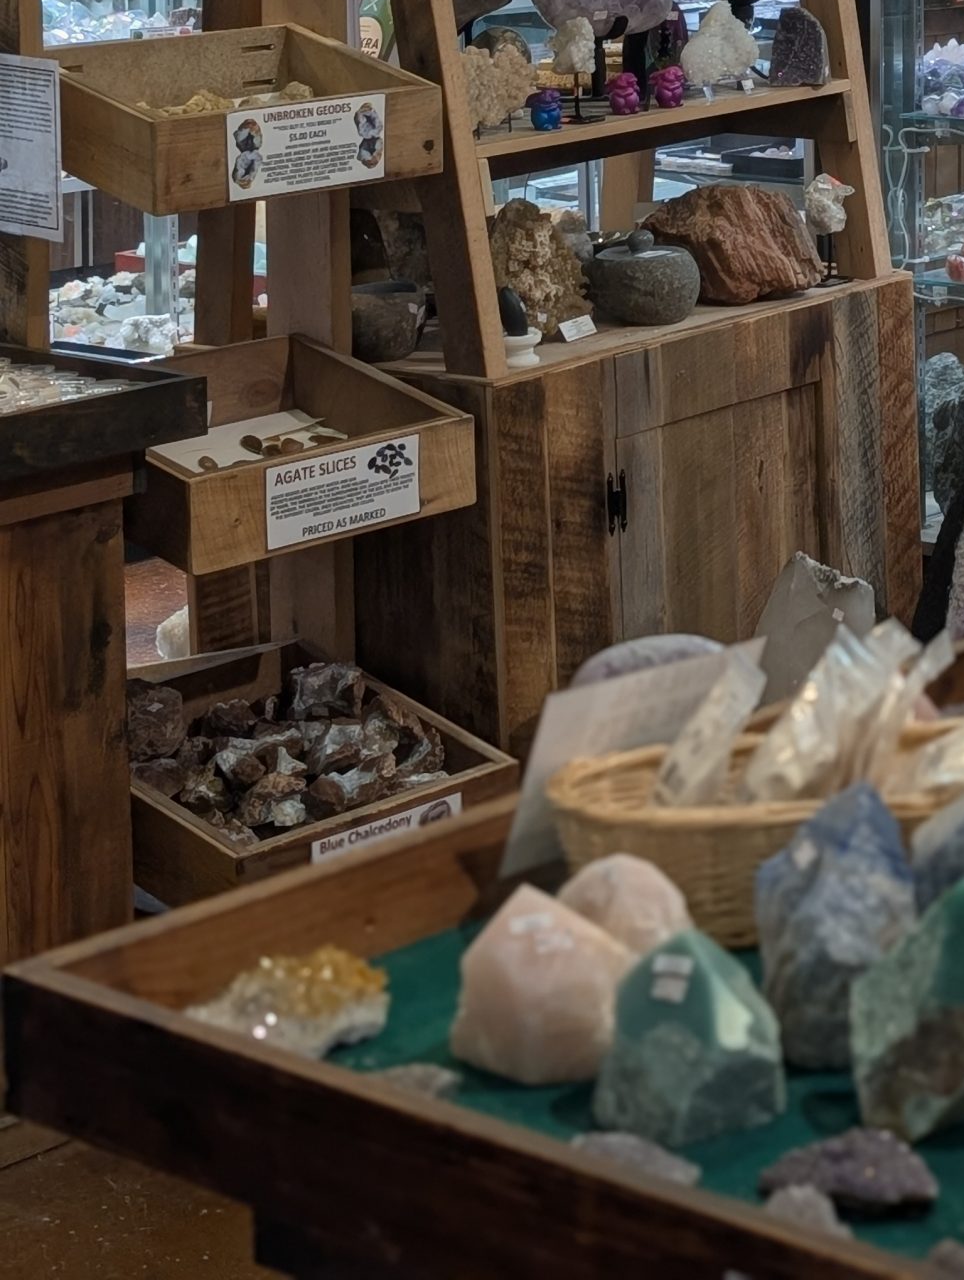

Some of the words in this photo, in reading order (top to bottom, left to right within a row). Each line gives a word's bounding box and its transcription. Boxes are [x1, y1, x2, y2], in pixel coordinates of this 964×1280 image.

[263, 108, 314, 123] UNBROKEN
[316, 103, 352, 116] GEODES
[289, 132, 308, 142] $5.00
[309, 129, 327, 140] EACH
[274, 465, 316, 487] AGATE
[319, 455, 357, 476] SLICES
[302, 522, 334, 537] PRICED
[335, 517, 347, 529] AS
[349, 508, 386, 526] MARKED
[320, 838, 345, 855] Blue
[347, 814, 413, 845] Chalcedony
